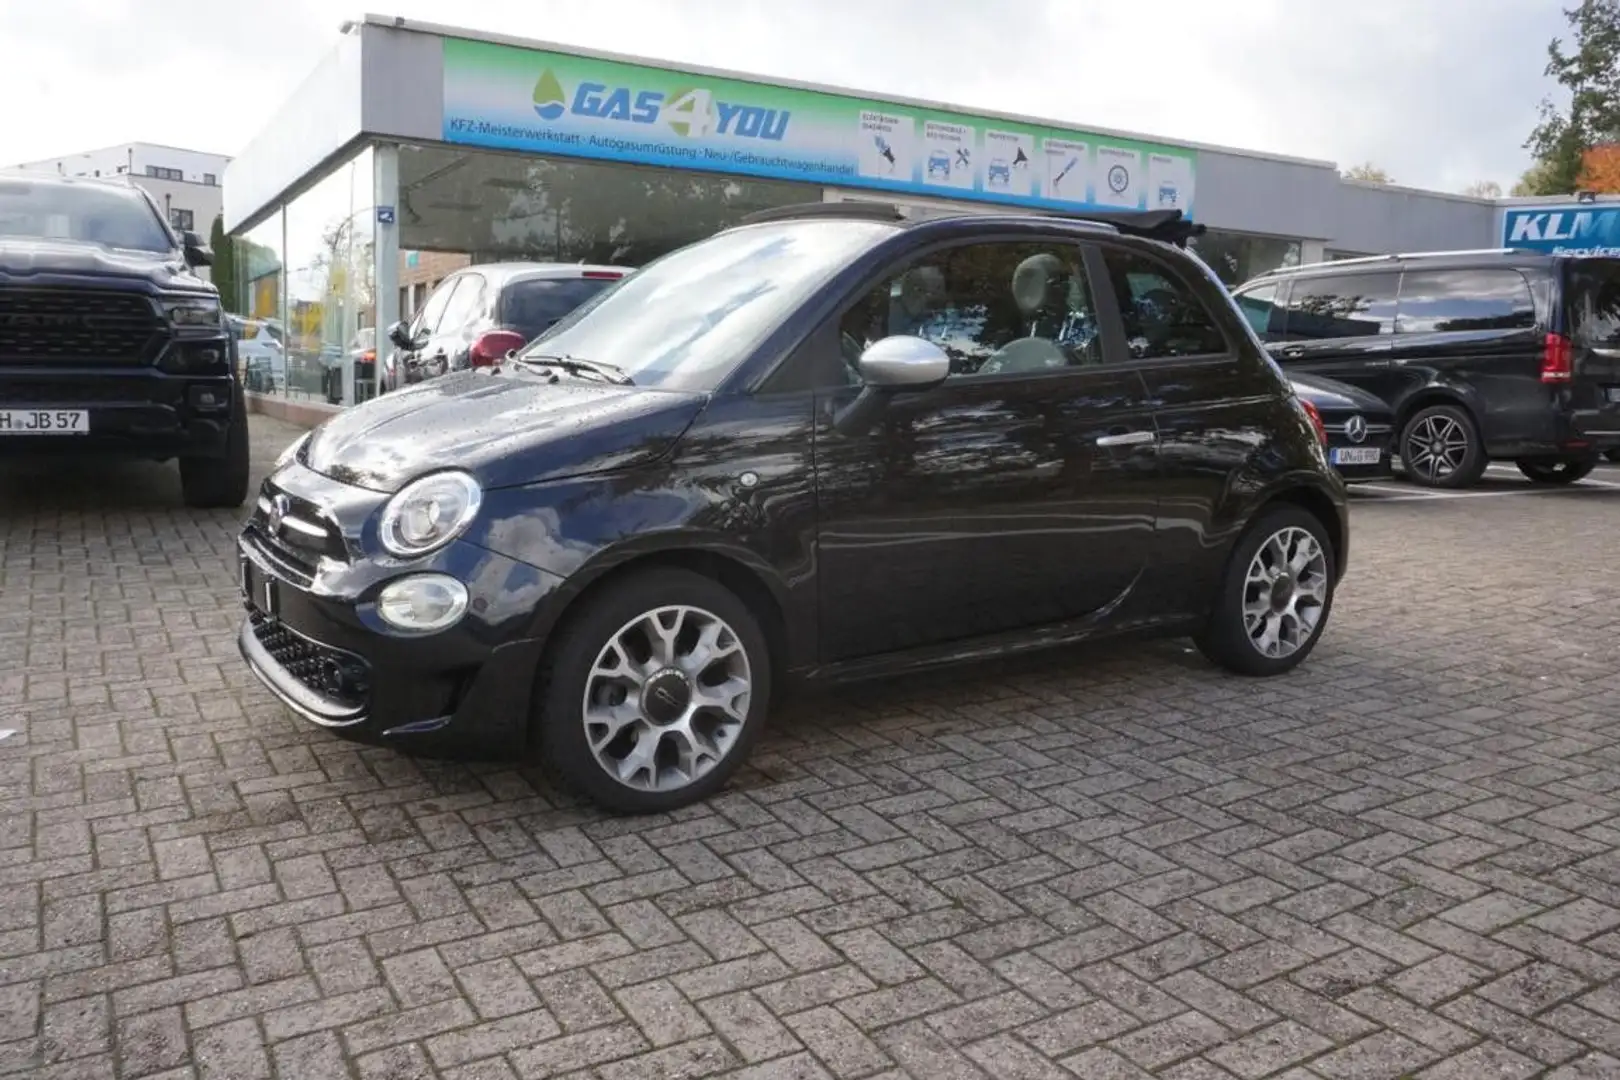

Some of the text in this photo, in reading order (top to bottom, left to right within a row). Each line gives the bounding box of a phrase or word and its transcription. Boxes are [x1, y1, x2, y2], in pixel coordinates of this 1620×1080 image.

[571, 82, 791, 141] GAS4YOU
[450, 118, 581, 145] KFZ-Meisterwerkstatt
[589, 134, 697, 160] Autogasumrüstung
[1509, 211, 1618, 242] KLM
[26, 412, 51, 429] JB
[56, 412, 80, 428] 57
